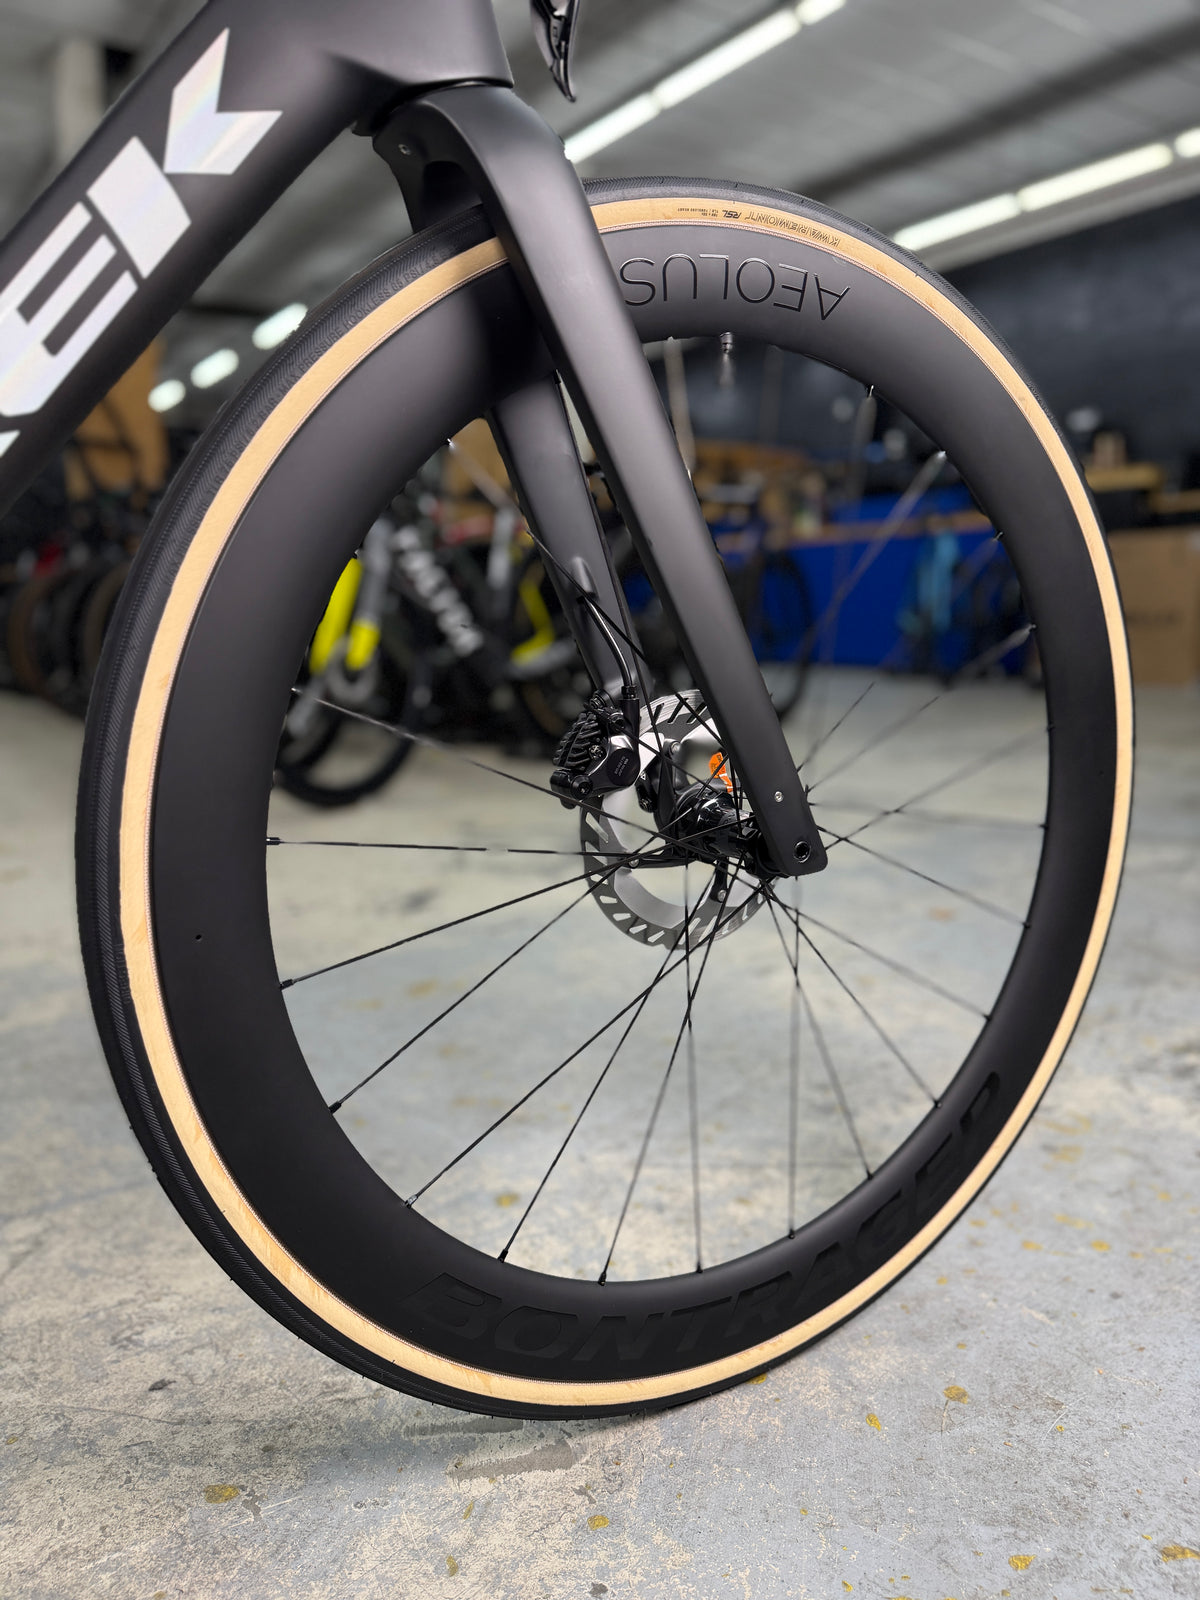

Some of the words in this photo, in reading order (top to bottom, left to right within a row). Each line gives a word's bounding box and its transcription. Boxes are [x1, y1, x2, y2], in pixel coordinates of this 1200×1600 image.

[721, 209, 742, 219] RSL
[744, 211, 841, 248] KWAREMONT
[620, 253, 850, 320] AEOLUS
[399, 1071, 1002, 1362] BONTRAGER
